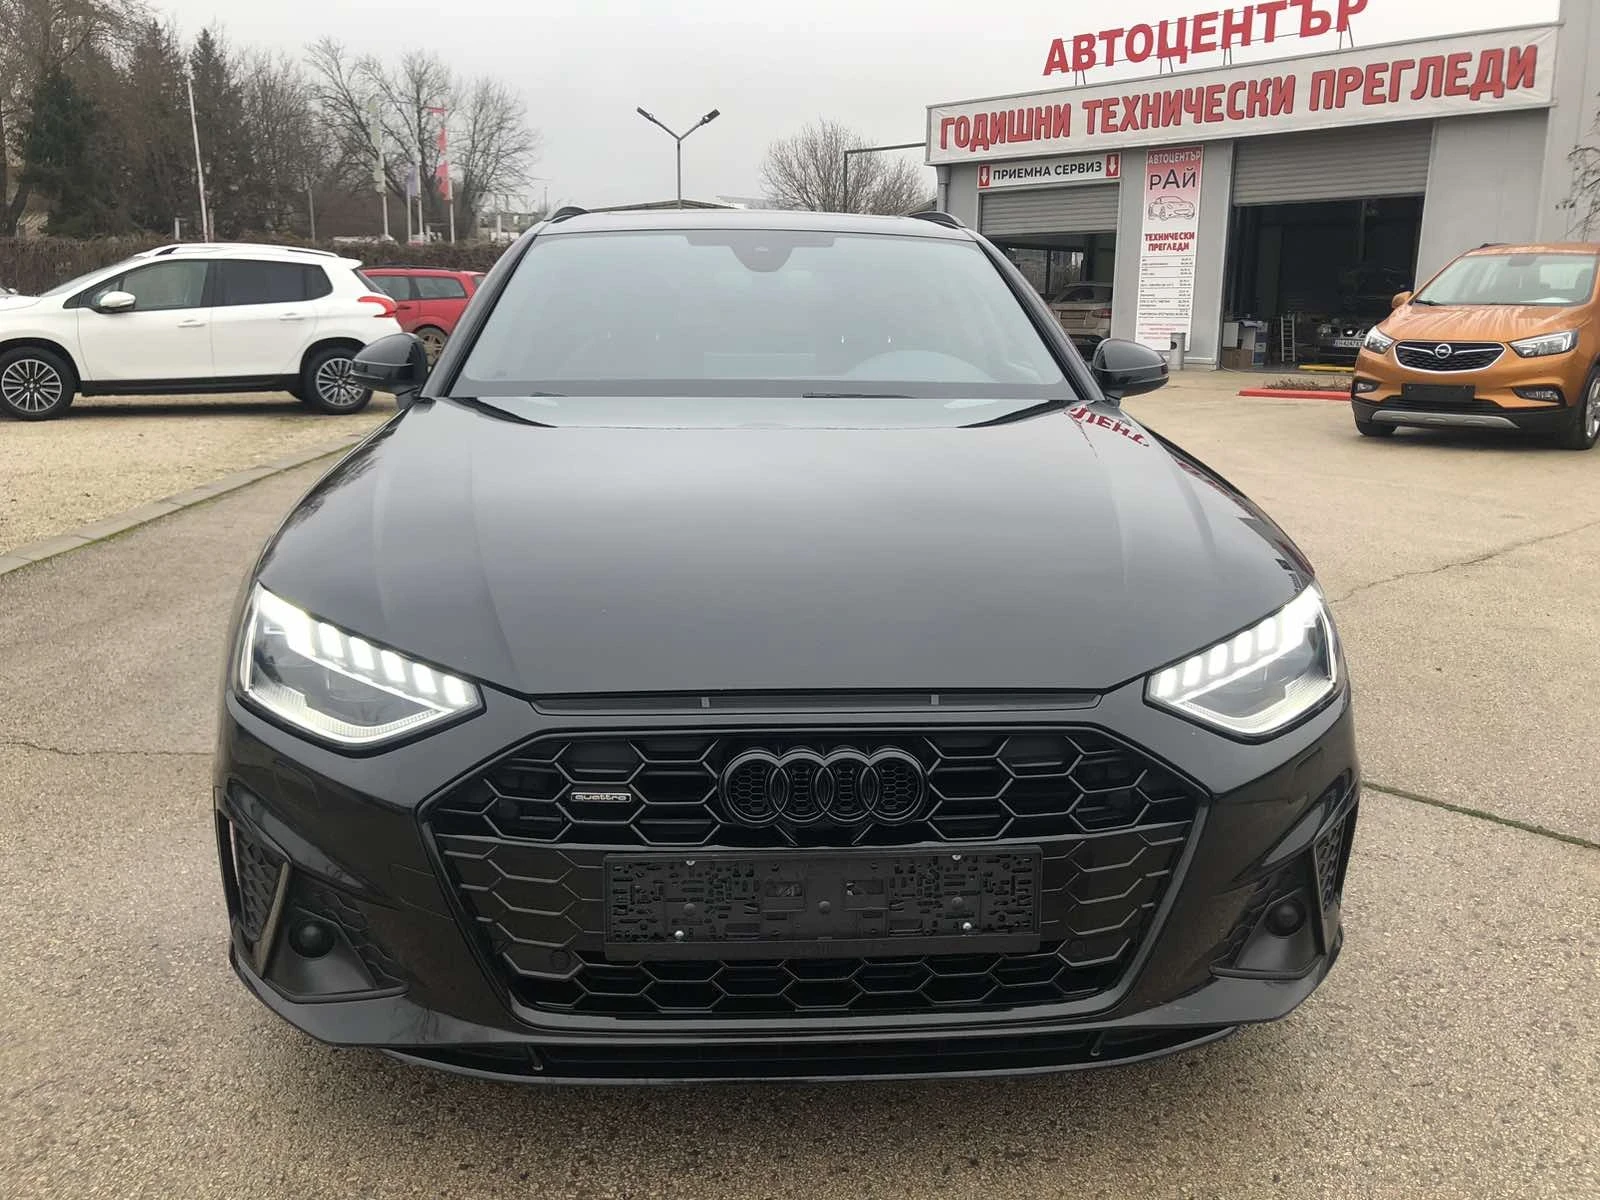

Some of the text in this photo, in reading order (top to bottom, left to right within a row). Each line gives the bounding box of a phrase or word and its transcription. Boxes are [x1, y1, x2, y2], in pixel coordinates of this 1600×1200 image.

[1043, 0, 1368, 76] АВТОЦЕНТЪР
[940, 44, 1538, 152] ГОДИШНИ ТЕХНИЧЕСКИ ПРЕГЛЕДИ
[1148, 151, 1201, 165] АВТОЦЕНТЪР
[992, 161, 1103, 181] ПРИЕМНА СЕРВИЗ
[1149, 167, 1197, 190] РАЙ
[1144, 231, 1195, 242] ТЕХНИЧЕСКИ
[1147, 241, 1190, 252] ПРЕГЛЕДИ
[575, 793, 627, 801] quattro
